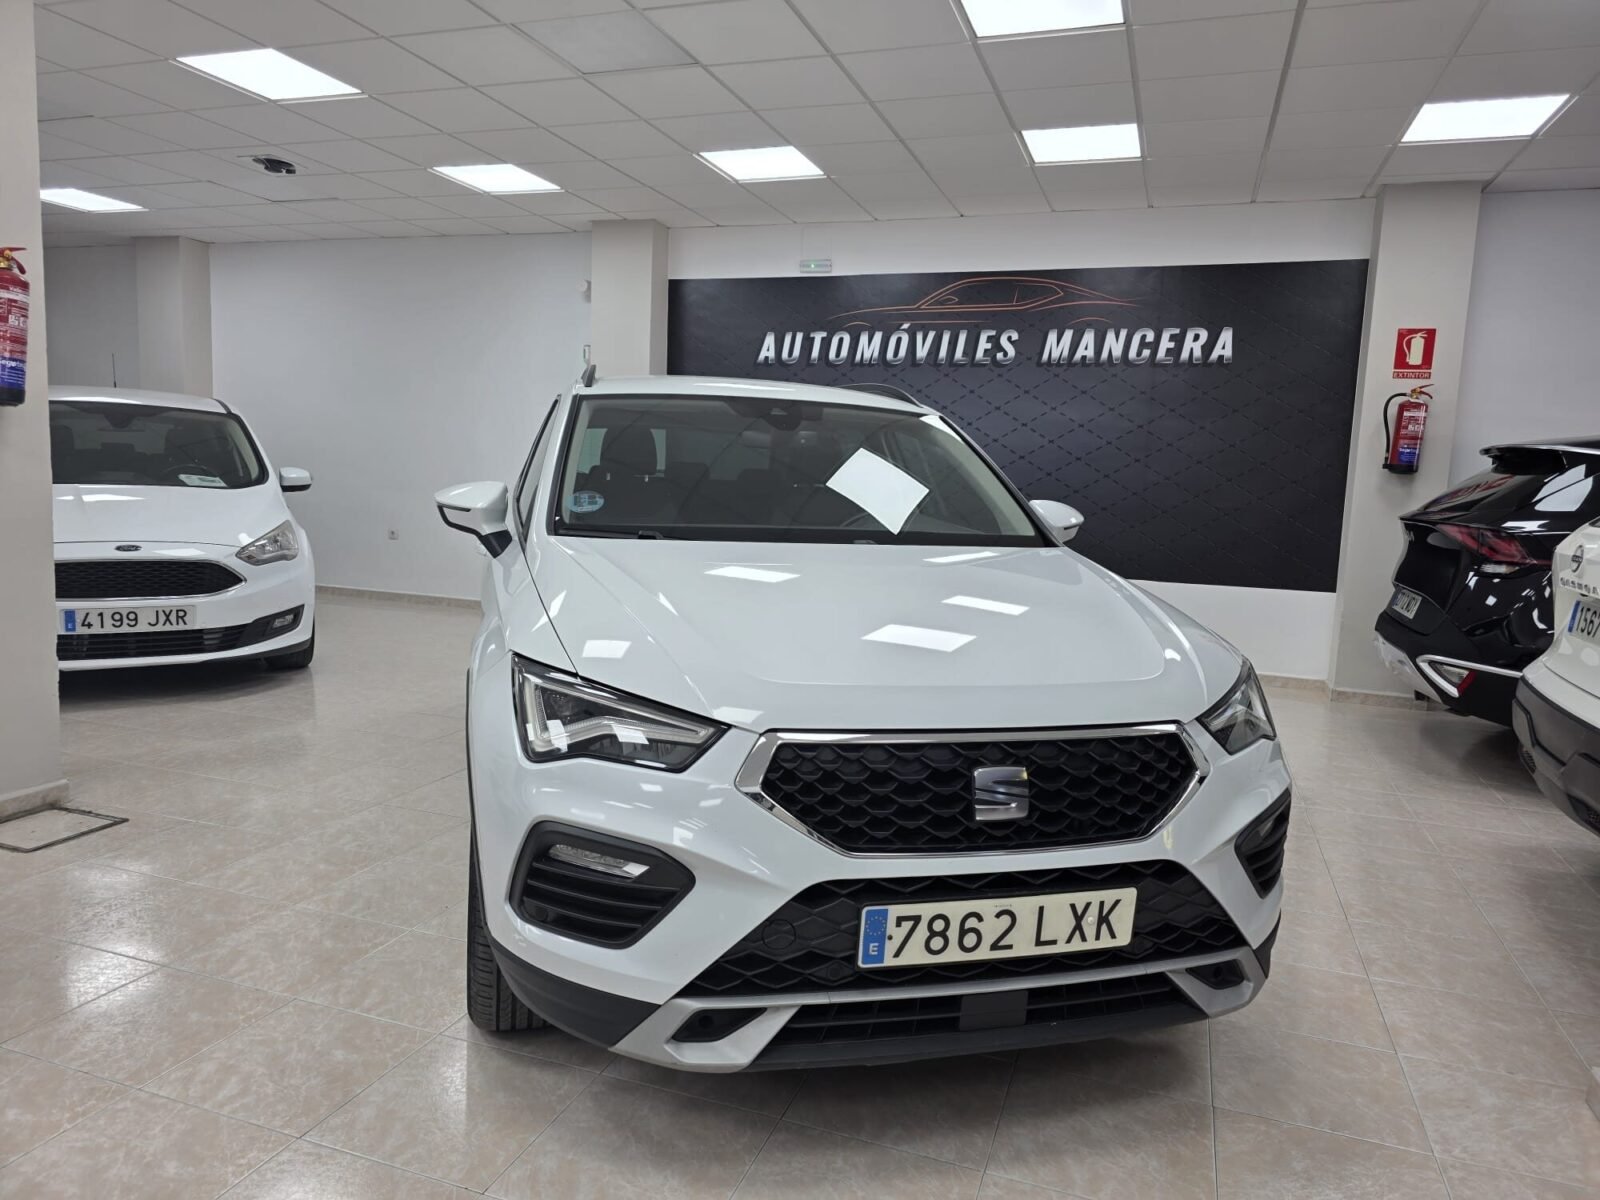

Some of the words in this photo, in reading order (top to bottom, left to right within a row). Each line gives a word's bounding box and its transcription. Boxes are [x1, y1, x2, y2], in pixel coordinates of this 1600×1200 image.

[757, 323, 1020, 365] AUTOMÓVILES
[1041, 326, 1234, 365] MANCERA
[81, 611, 139, 630] 4199
[148, 608, 188, 627] JXR
[892, 908, 1018, 959] 7862
[1034, 898, 1123, 947] LXK
[868, 942, 879, 956] E
